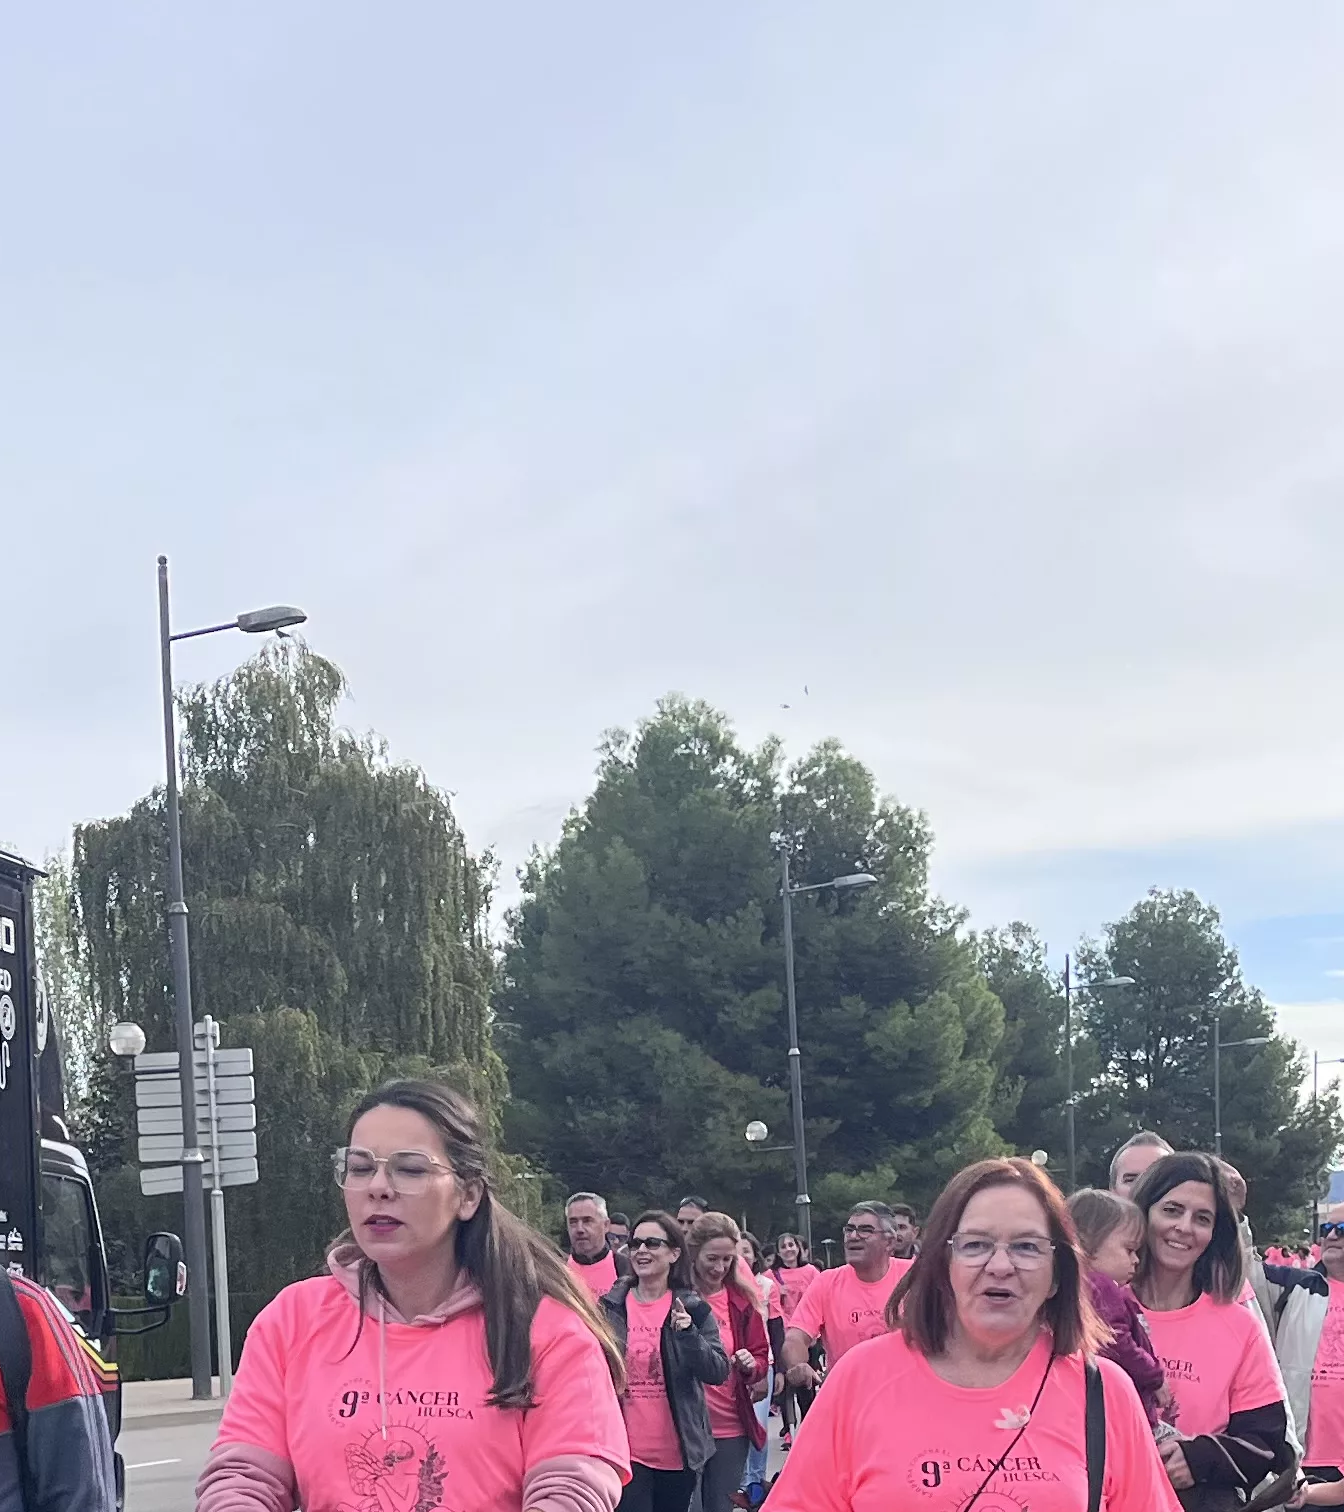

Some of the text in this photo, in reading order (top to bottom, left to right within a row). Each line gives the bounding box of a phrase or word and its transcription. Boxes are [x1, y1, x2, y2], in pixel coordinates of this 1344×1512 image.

[376, 1387, 460, 1406] CÁNCER
[417, 1406, 475, 1420] HUESCA
[957, 1453, 1042, 1473] CÁNCER
[1003, 1471, 1061, 1483] HUESCA
